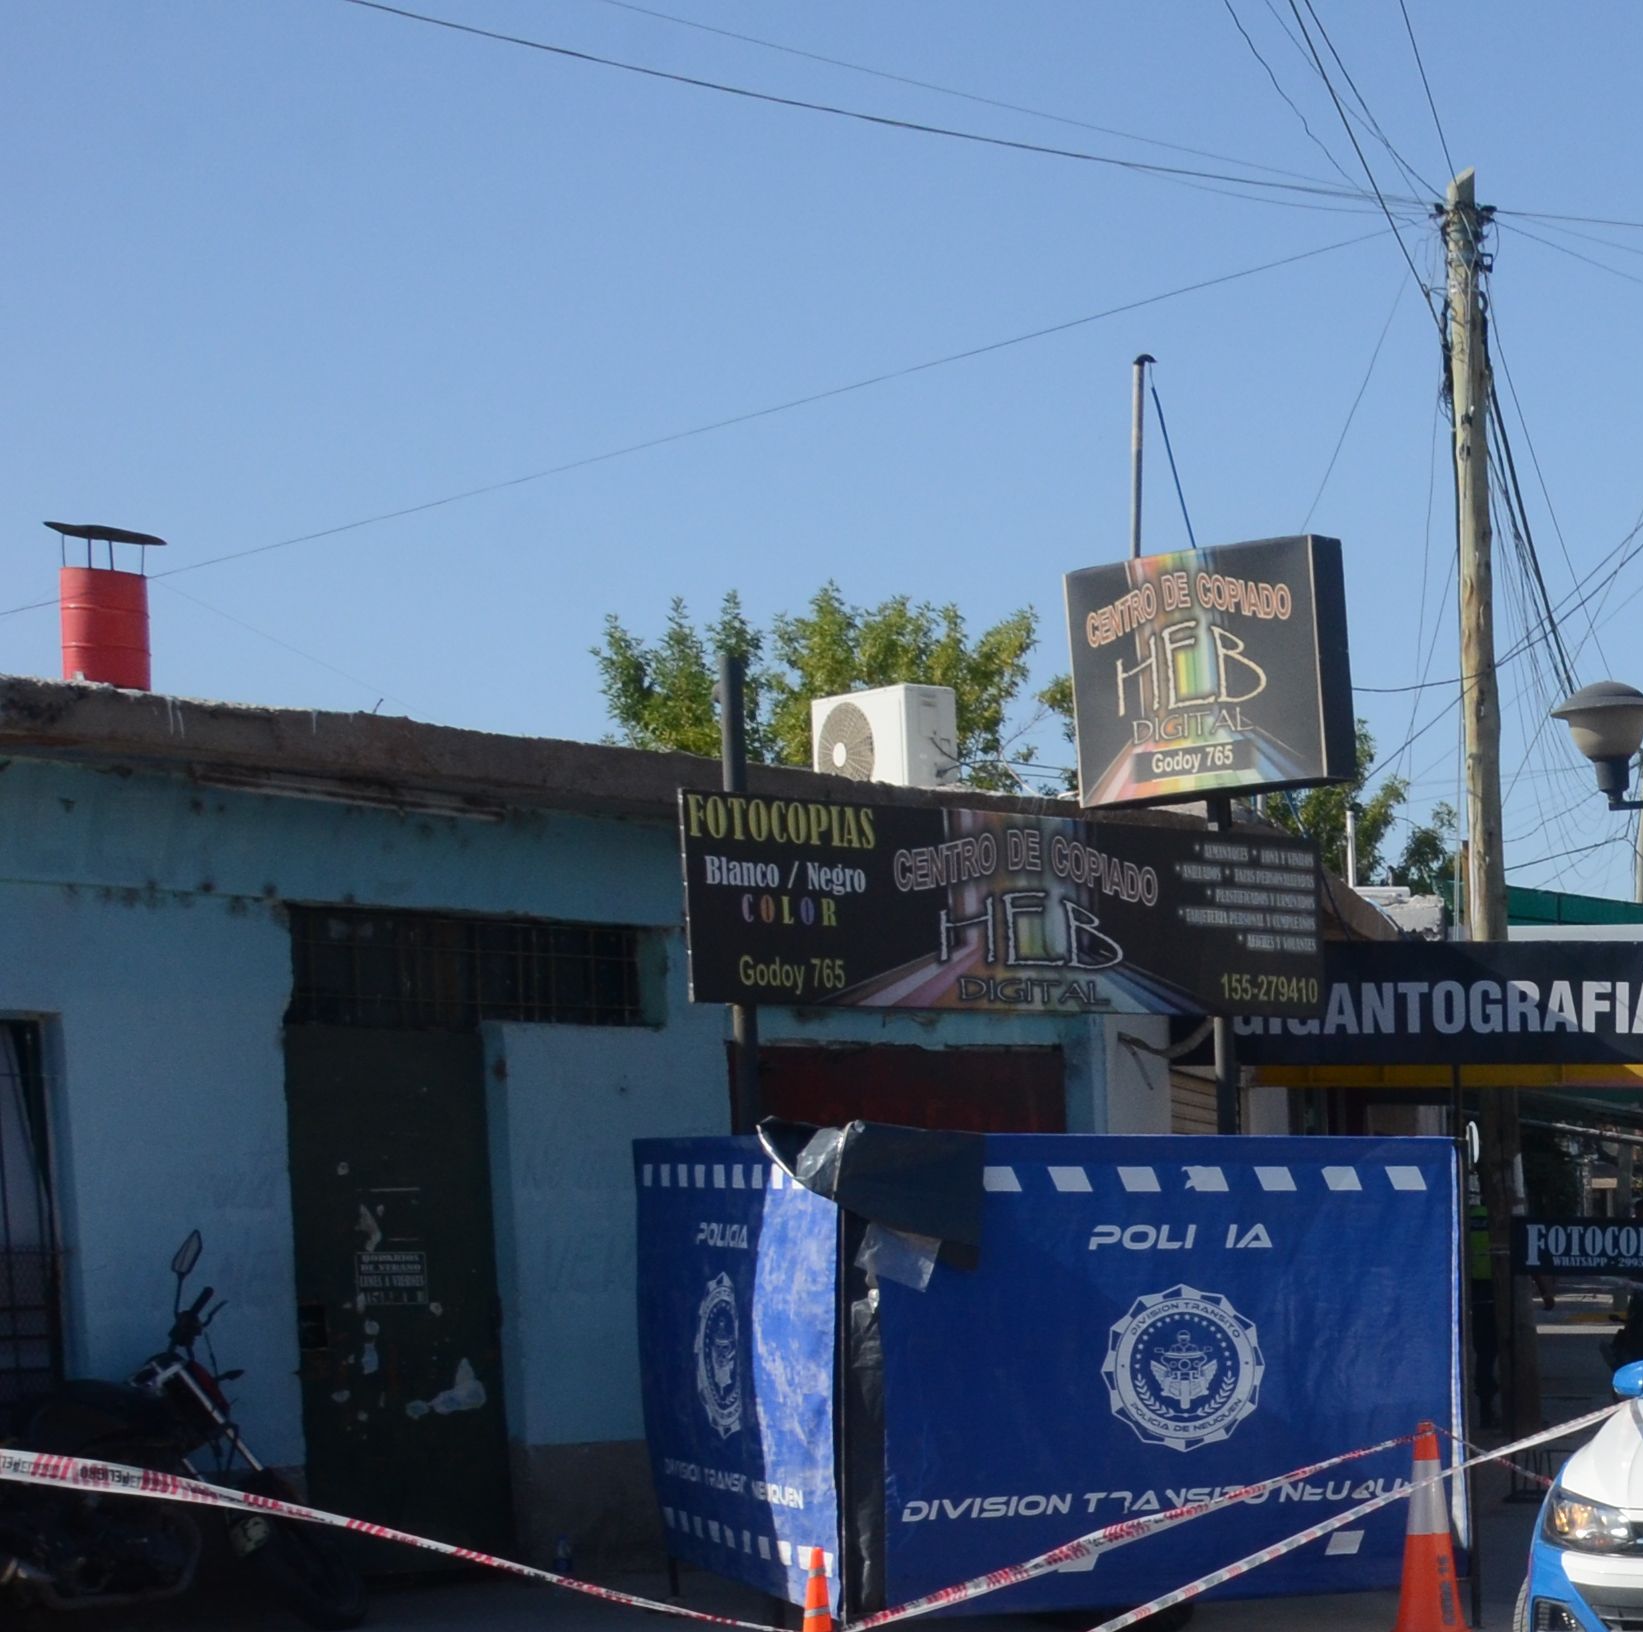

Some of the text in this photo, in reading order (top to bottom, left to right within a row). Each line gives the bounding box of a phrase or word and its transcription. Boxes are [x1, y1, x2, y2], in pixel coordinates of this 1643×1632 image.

[1086, 572, 1292, 648] CENTRO DE COPIADO
[1116, 621, 1267, 717] HEB
[1132, 706, 1254, 745] DIGITAL
[1152, 745, 1233, 775] Godoy 765
[687, 794, 876, 849] FOTOCOPIAS
[704, 855, 867, 895] Blanco / Negro
[893, 829, 1159, 907] CENTRO DE COPIADO
[741, 894, 838, 926] COLOR
[940, 891, 1123, 970] HEB
[739, 954, 846, 995] Godoy 765
[959, 977, 1112, 1006] DIGITAL
[1220, 973, 1318, 1004] 155-279410
[1552, 1255, 1608, 1268] WHATSAPP
[1131, 1300, 1242, 1339] DIVISION TRANSITO
[1130, 1397, 1243, 1433] POLICIA DE NEUQUEN
[902, 1492, 1071, 1524] DIVISION
